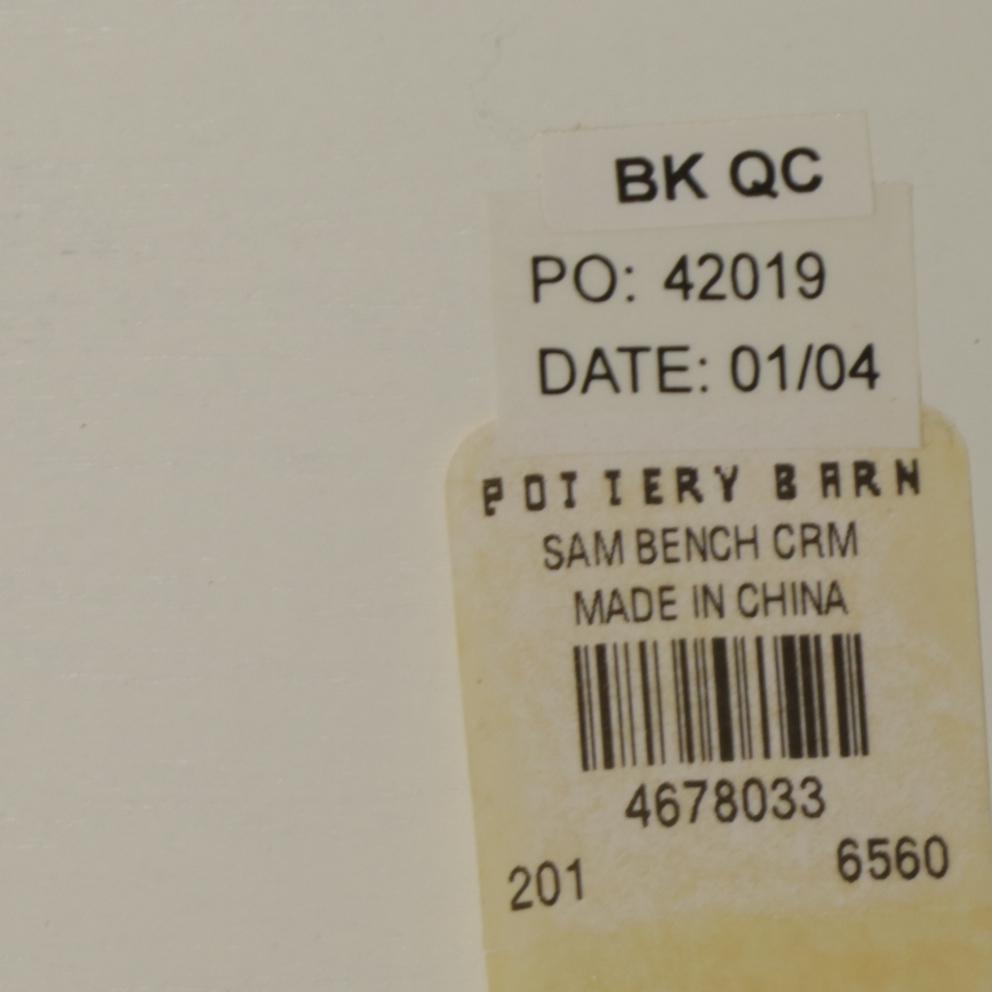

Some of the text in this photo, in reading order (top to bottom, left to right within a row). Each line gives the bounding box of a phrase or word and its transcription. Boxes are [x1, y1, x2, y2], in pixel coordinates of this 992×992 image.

[615, 147, 824, 205] BK QC
[530, 250, 828, 304] PO: 42019
[537, 342, 882, 396] DATE: 01/04
[772, 458, 921, 502] BARN
[542, 521, 859, 571] SAM BENCH CRM
[574, 580, 849, 626] MADE IN CHINA
[625, 776, 827, 829] 4678033
[508, 858, 585, 912] 201
[835, 834, 951, 885] 6560
